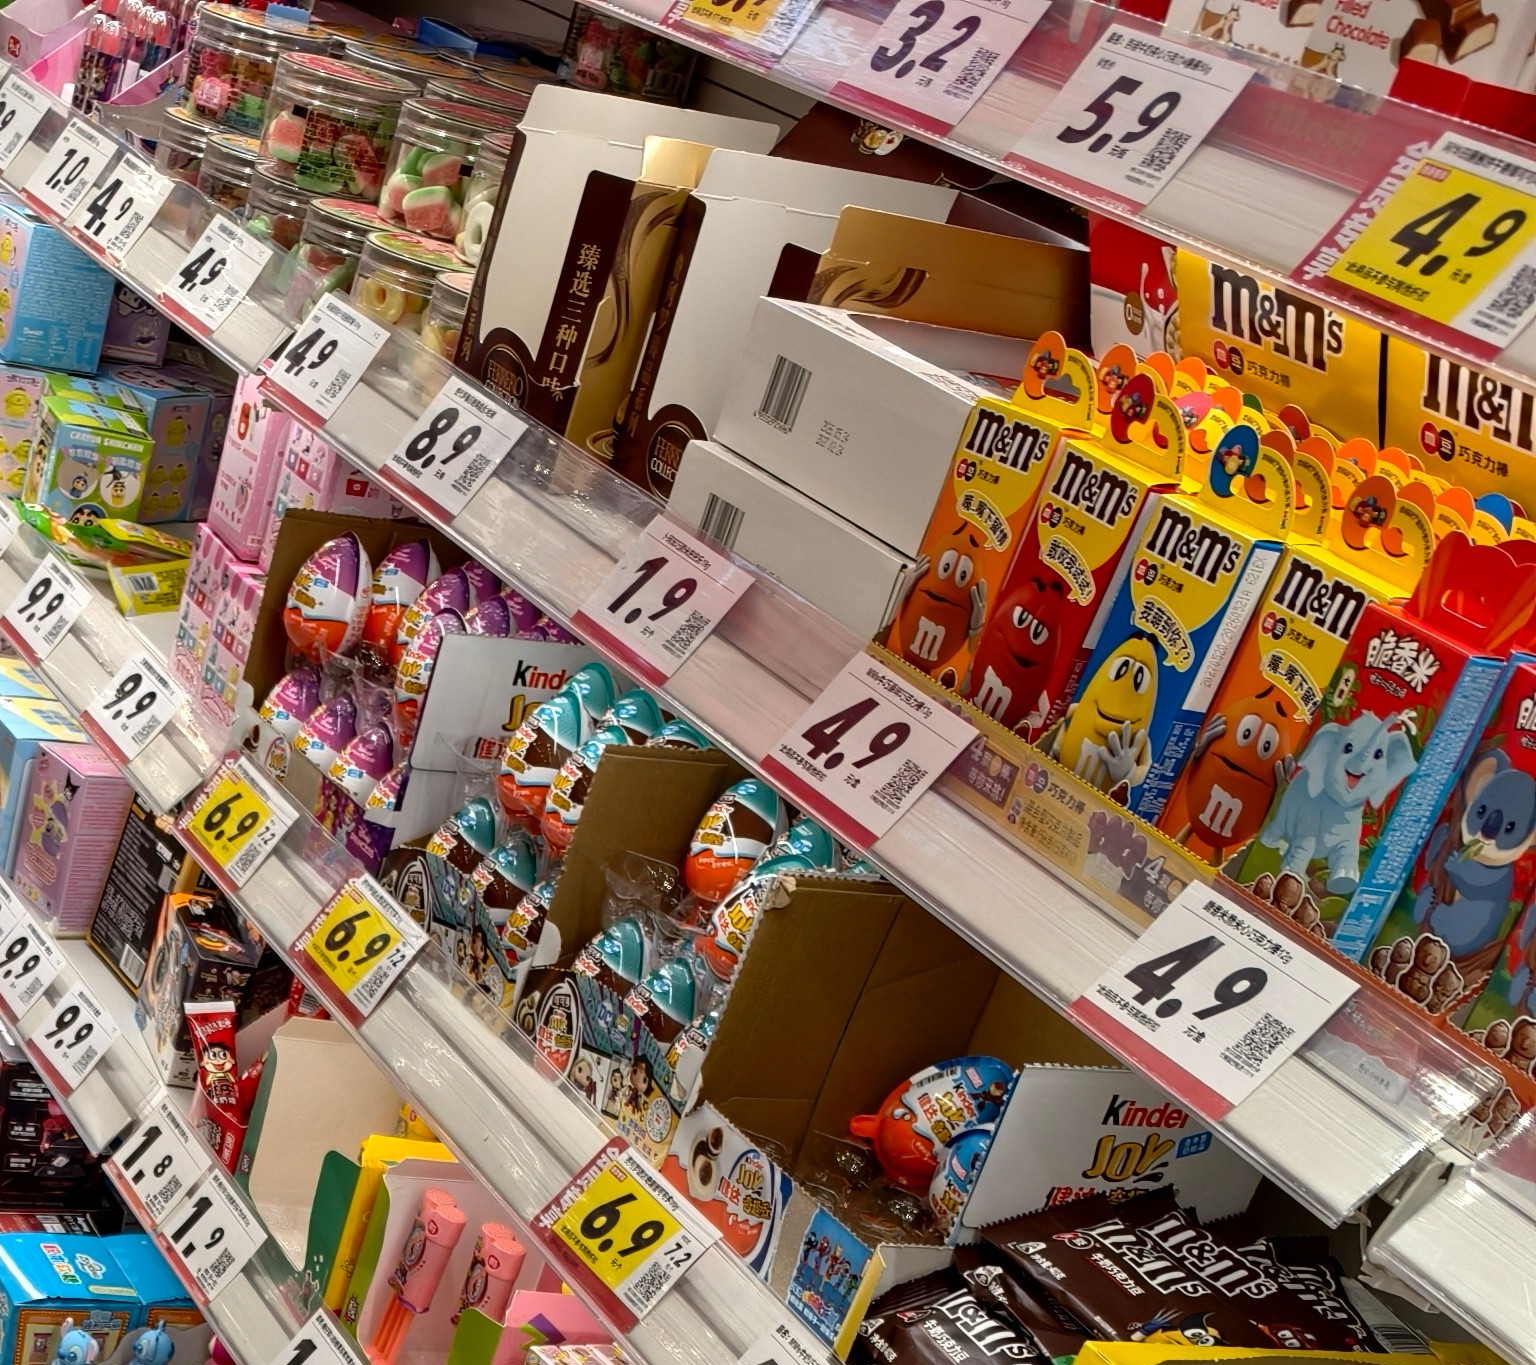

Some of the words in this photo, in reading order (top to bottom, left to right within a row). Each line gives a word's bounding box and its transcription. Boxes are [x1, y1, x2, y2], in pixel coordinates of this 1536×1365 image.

[871, 0, 981, 78] 3.2
[1057, 76, 1181, 153] 5.9
[46, 149, 89, 189] 1.0
[84, 179, 133, 236] 4.9
[1390, 193, 1526, 276] 4.9
[179, 248, 226, 291] 4.9
[285, 328, 338, 376] 4.9
[541, 243, 600, 402] 臻选三种口味
[406, 408, 481, 469] 8.9
[967, 409, 1049, 474] m&m's
[1459, 446, 1509, 477] 巧克力棒
[1052, 452, 1136, 528] m&m's
[1146, 506, 1242, 585] m&m's
[18, 578, 64, 622] 9.9
[607, 557, 697, 623] 1.9
[1366, 630, 1440, 693] 脆香米
[110, 673, 158, 719] 9.9
[802, 698, 910, 769] 4.9
[204, 793, 259, 842] 6.9
[325, 911, 390, 966] 6.9
[1124, 936, 1267, 1020] 4.9
[45, 1006, 93, 1049] 9.9
[122, 1126, 172, 1184] 1.8
[171, 1197, 224, 1258] 1.9
[581, 1193, 664, 1257] 6.9
[664, 1243, 691, 1267] 7.2
[1090, 1253, 1146, 1296] 牛奶巧克力豆
